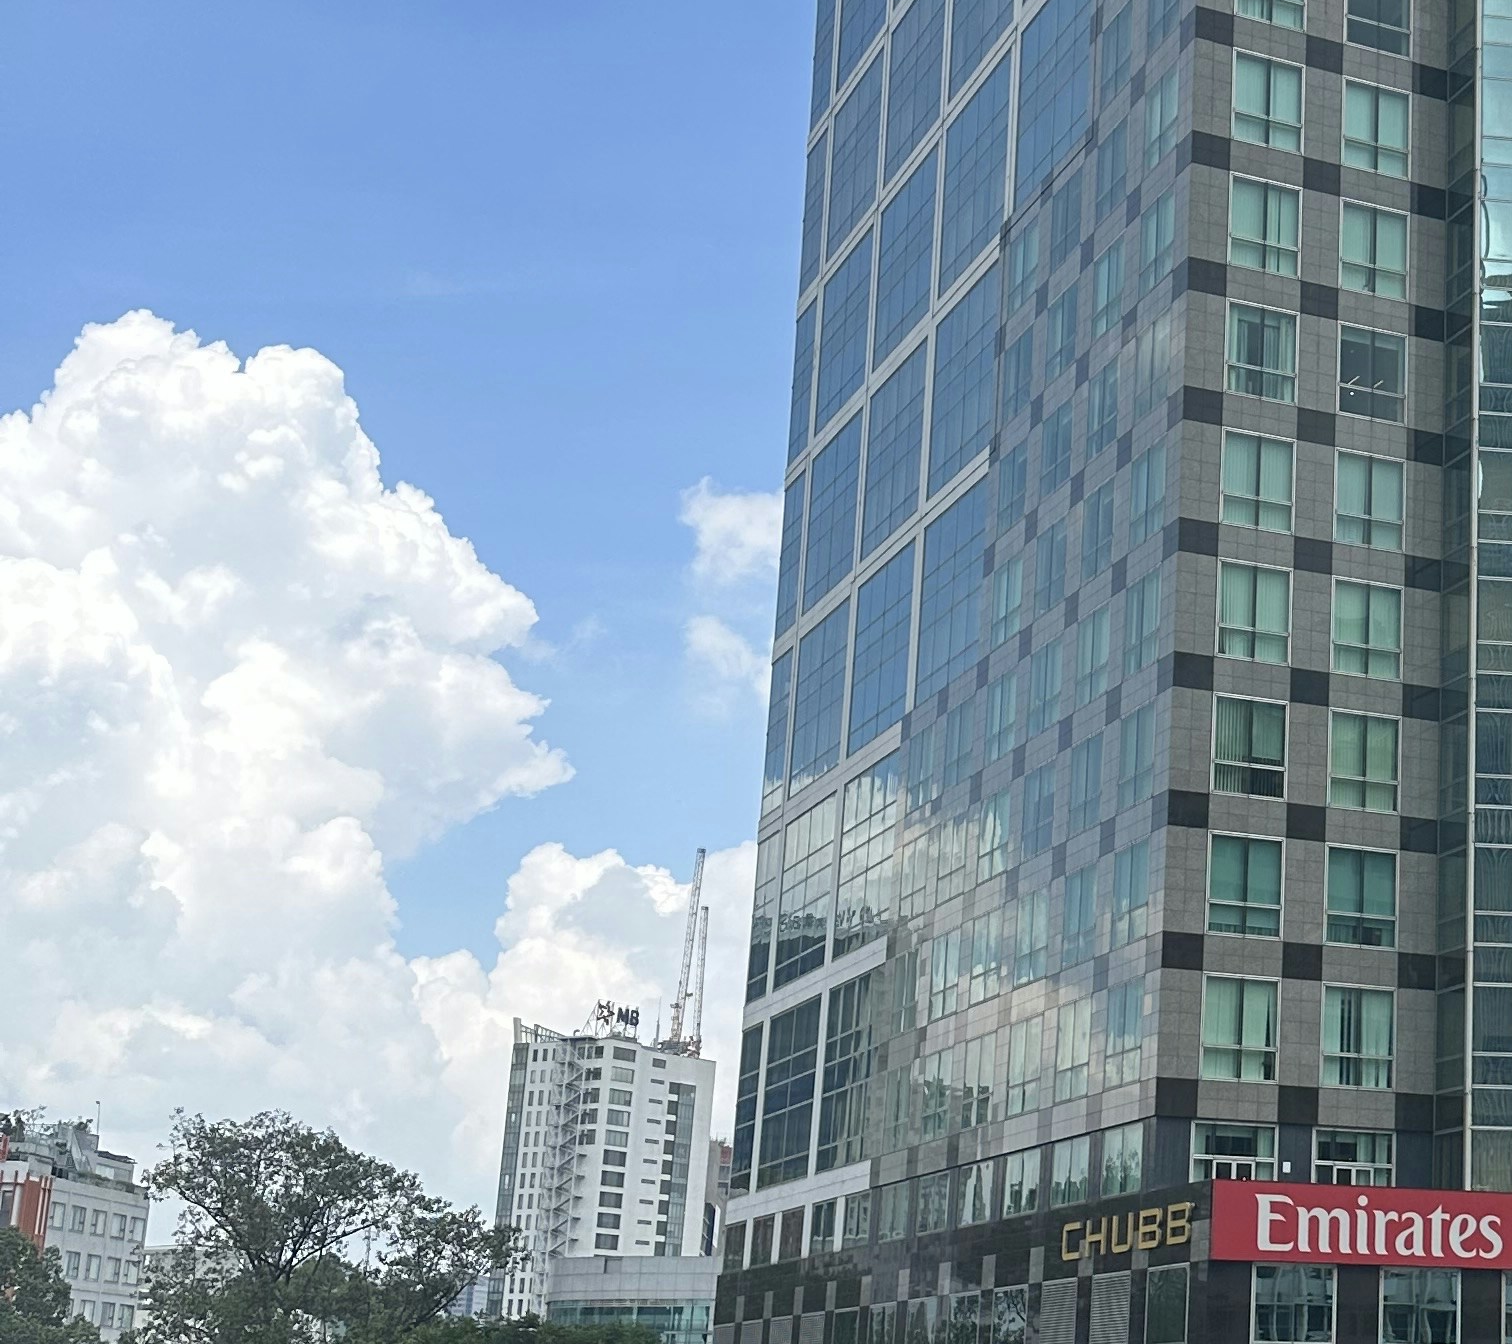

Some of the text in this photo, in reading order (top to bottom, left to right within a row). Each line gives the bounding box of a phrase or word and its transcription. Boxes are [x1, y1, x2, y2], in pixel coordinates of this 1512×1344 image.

[616, 1006, 640, 1026] MB
[1061, 1202, 1193, 1261] CHUBB
[1255, 1193, 1504, 1260] Emirates
